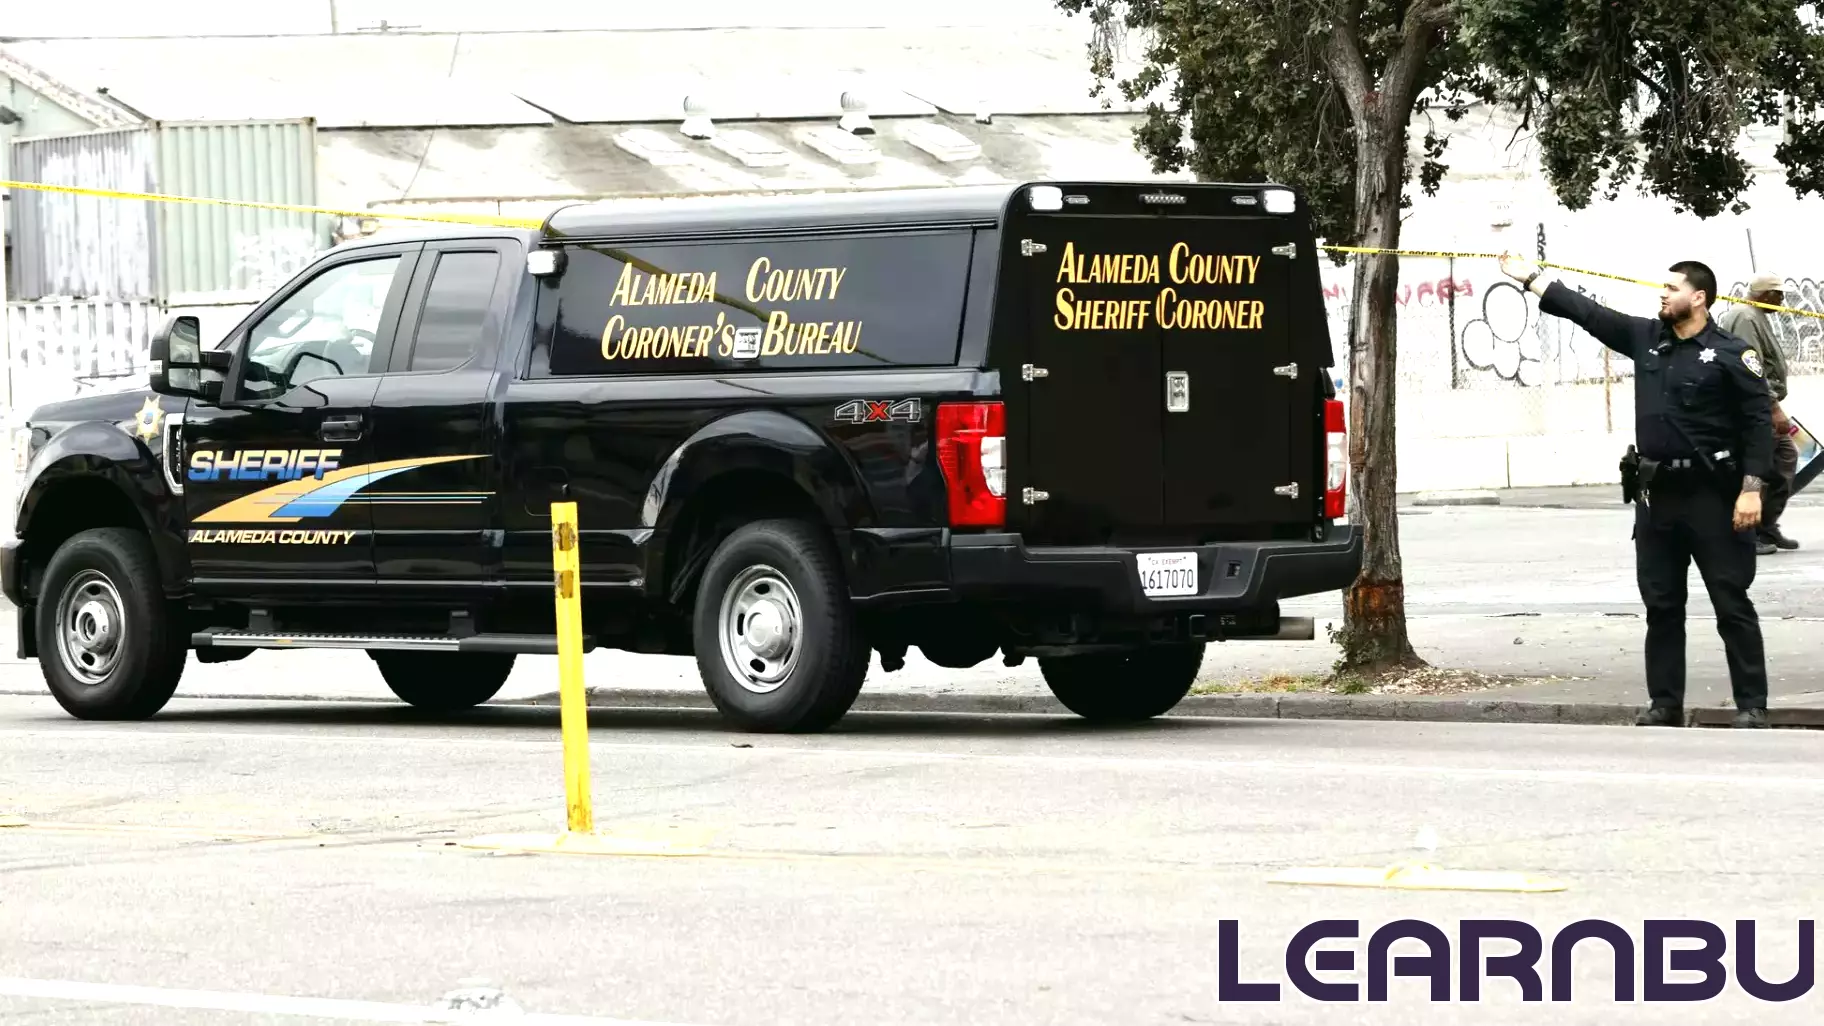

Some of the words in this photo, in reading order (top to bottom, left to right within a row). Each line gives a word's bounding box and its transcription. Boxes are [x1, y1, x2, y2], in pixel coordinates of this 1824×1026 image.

[609, 261, 717, 307] ALAMEDA
[745, 256, 848, 303] COUNTY
[1056, 241, 1161, 284] ALAMEDA
[1169, 241, 1262, 285] COUNTY
[1053, 286, 1152, 331] SHERIFF
[1155, 286, 1265, 330] CORONER
[601, 311, 735, 361] CORONER'S
[760, 310, 863, 357] BUREAU
[188, 449, 342, 481] SHERIFF
[189, 529, 276, 544] ALAMEDA
[278, 531, 356, 545] COUNTY
[1142, 569, 1194, 590] 1617070
